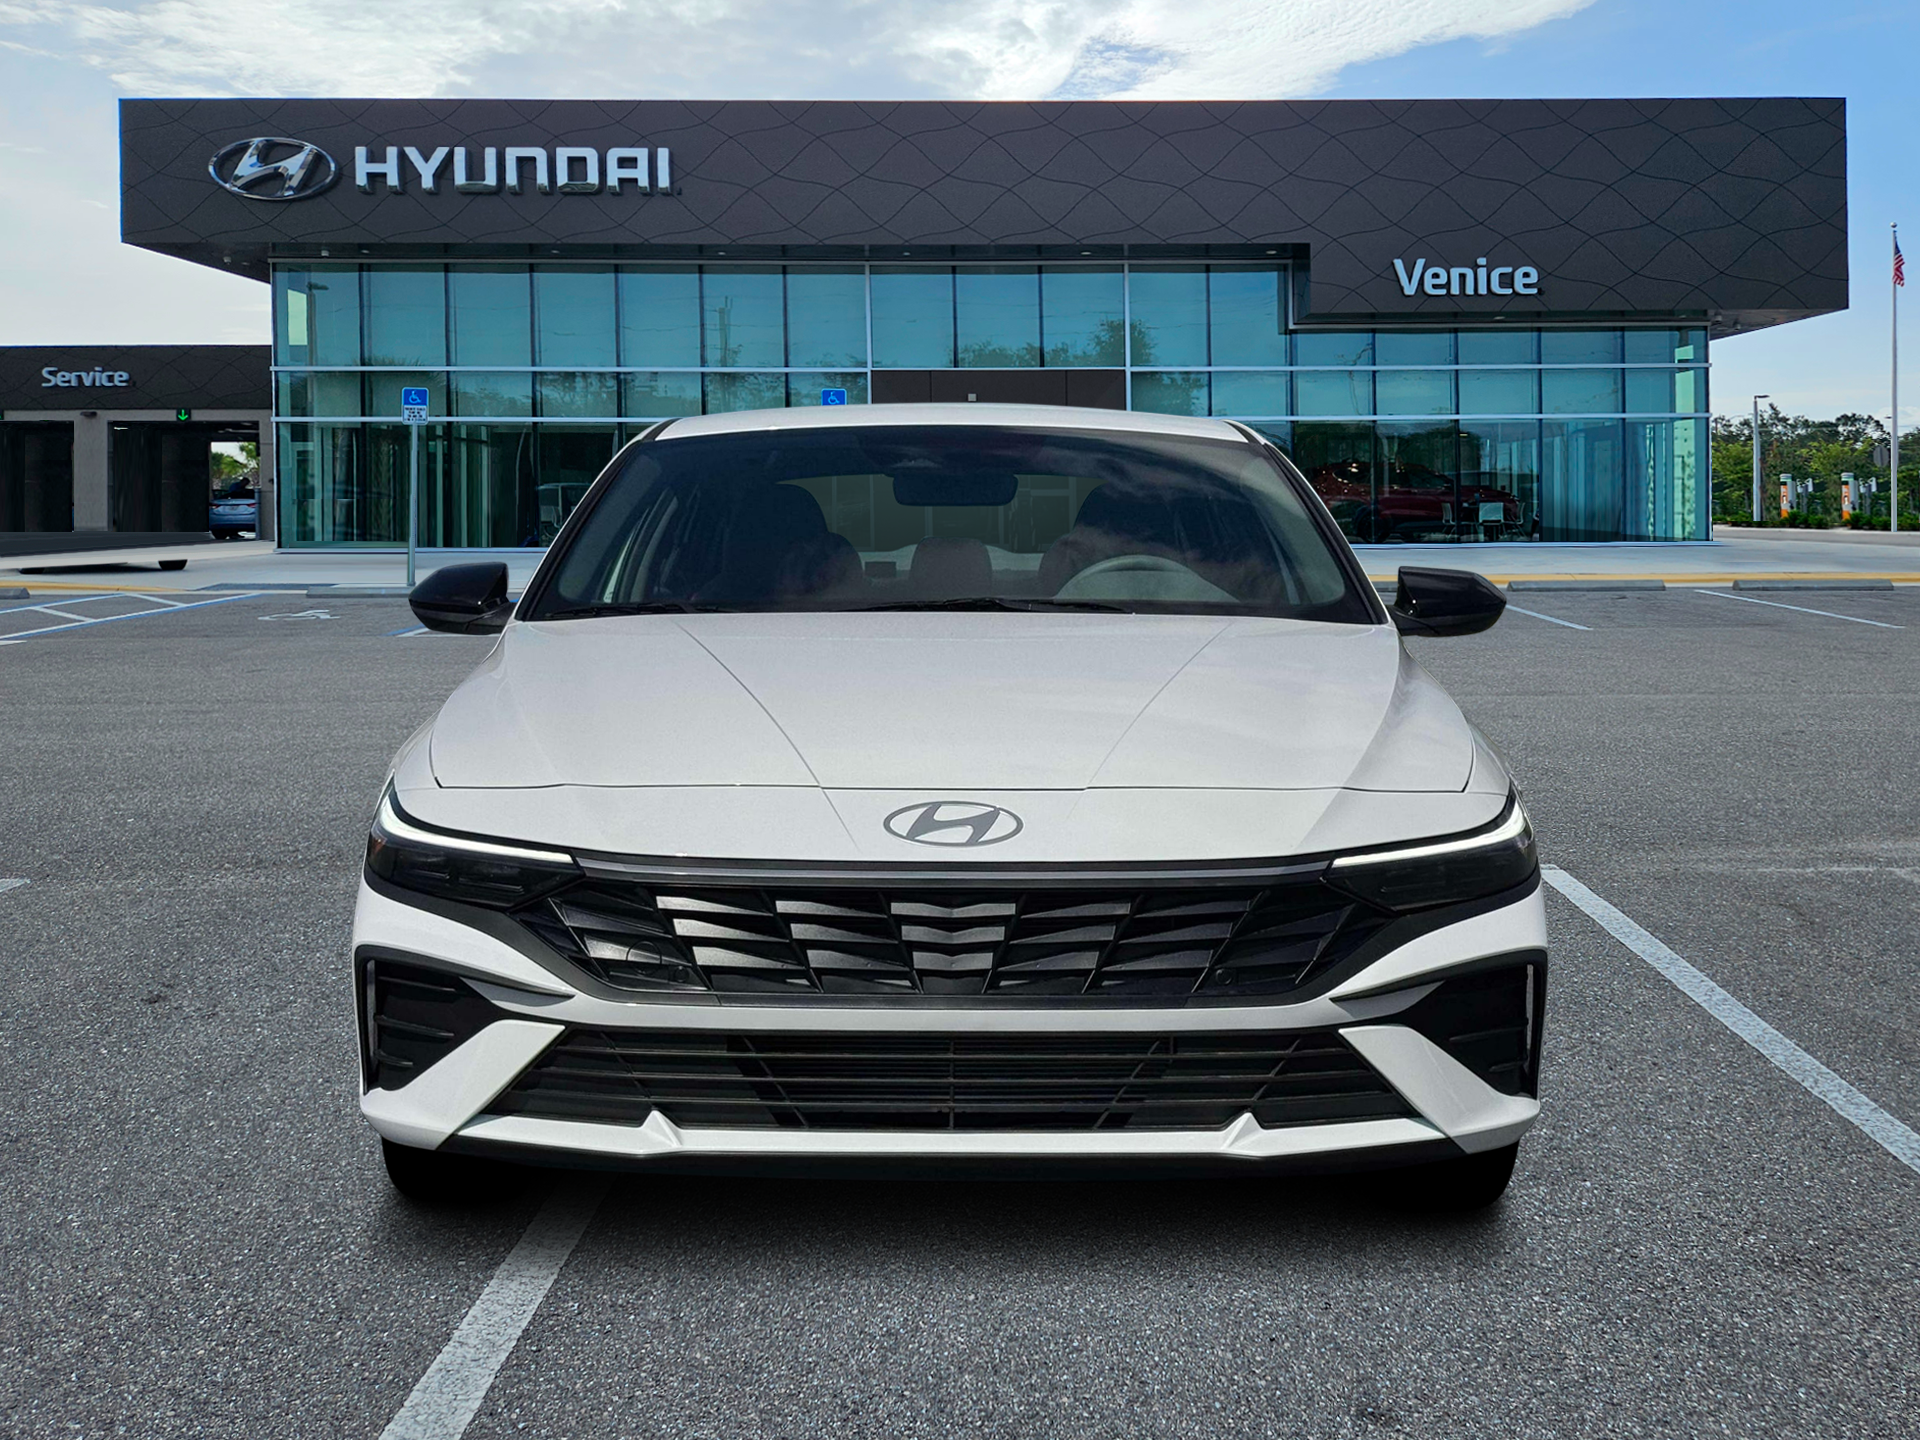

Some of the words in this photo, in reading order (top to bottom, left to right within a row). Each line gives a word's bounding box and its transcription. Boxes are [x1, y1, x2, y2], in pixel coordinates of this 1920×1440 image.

[354, 146, 673, 194] HYUNDAI
[1393, 257, 1538, 295] Venice
[41, 366, 130, 387] Service
